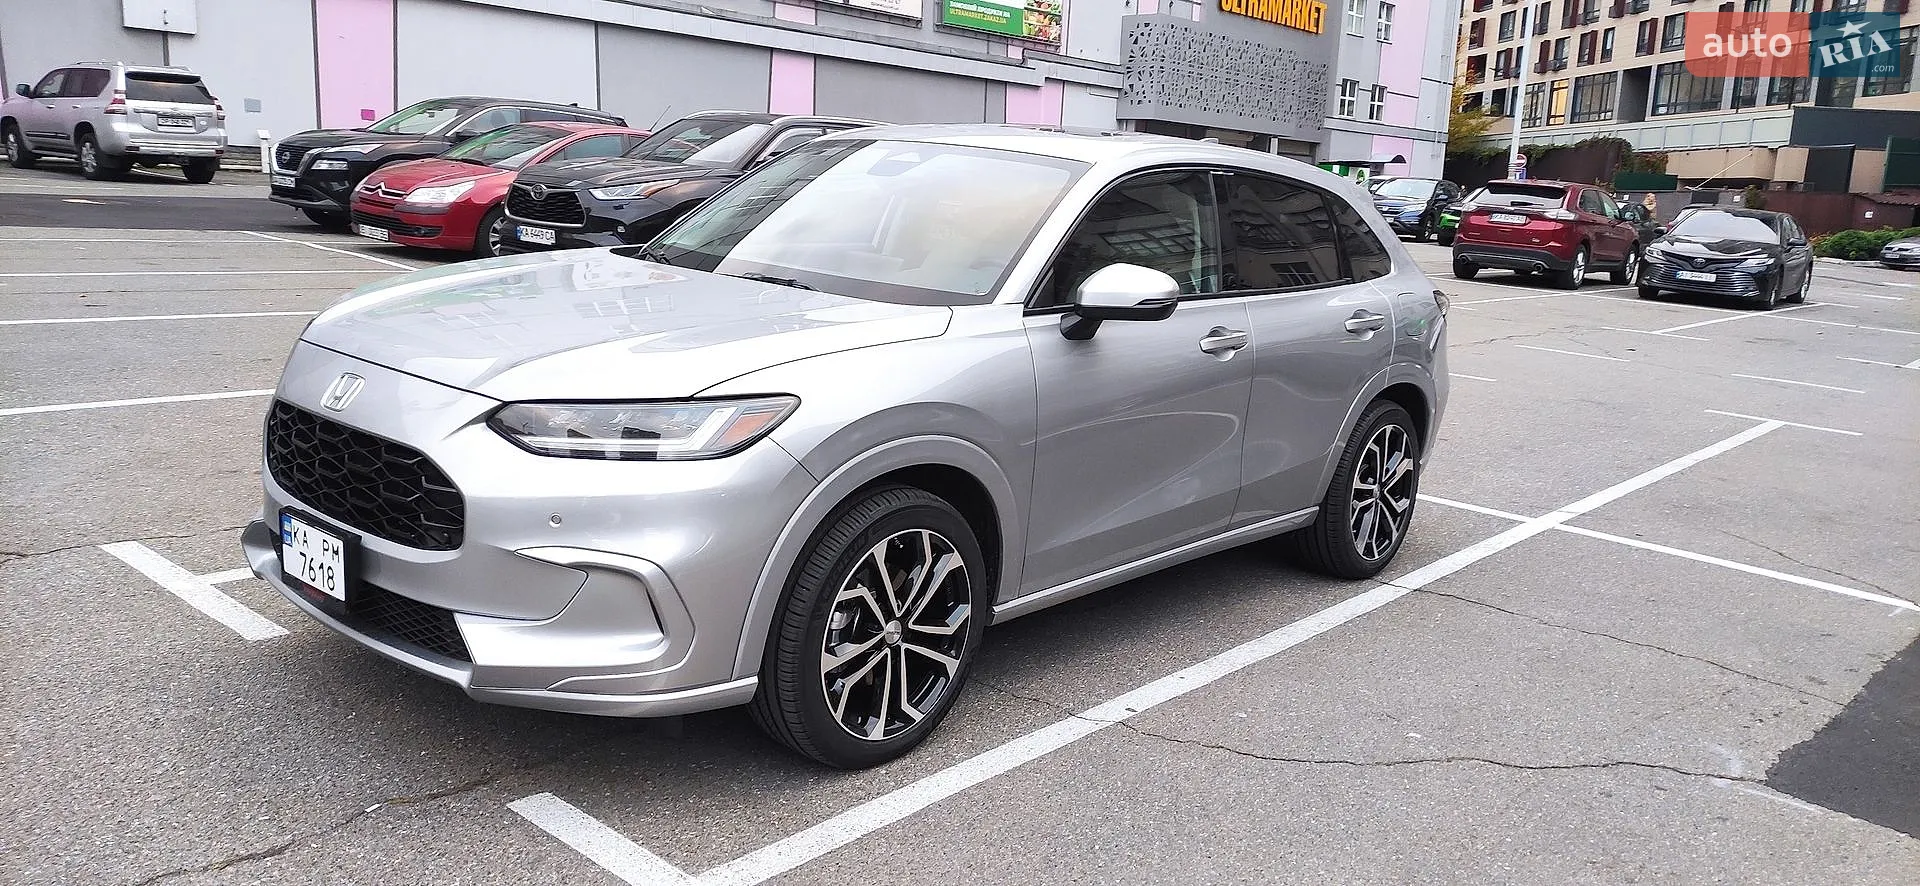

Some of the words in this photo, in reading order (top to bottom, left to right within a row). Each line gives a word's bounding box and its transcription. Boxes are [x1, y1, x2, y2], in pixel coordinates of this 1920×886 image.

[293, 526, 309, 550] KA
[322, 538, 340, 563] PM
[299, 551, 336, 592] 7618
